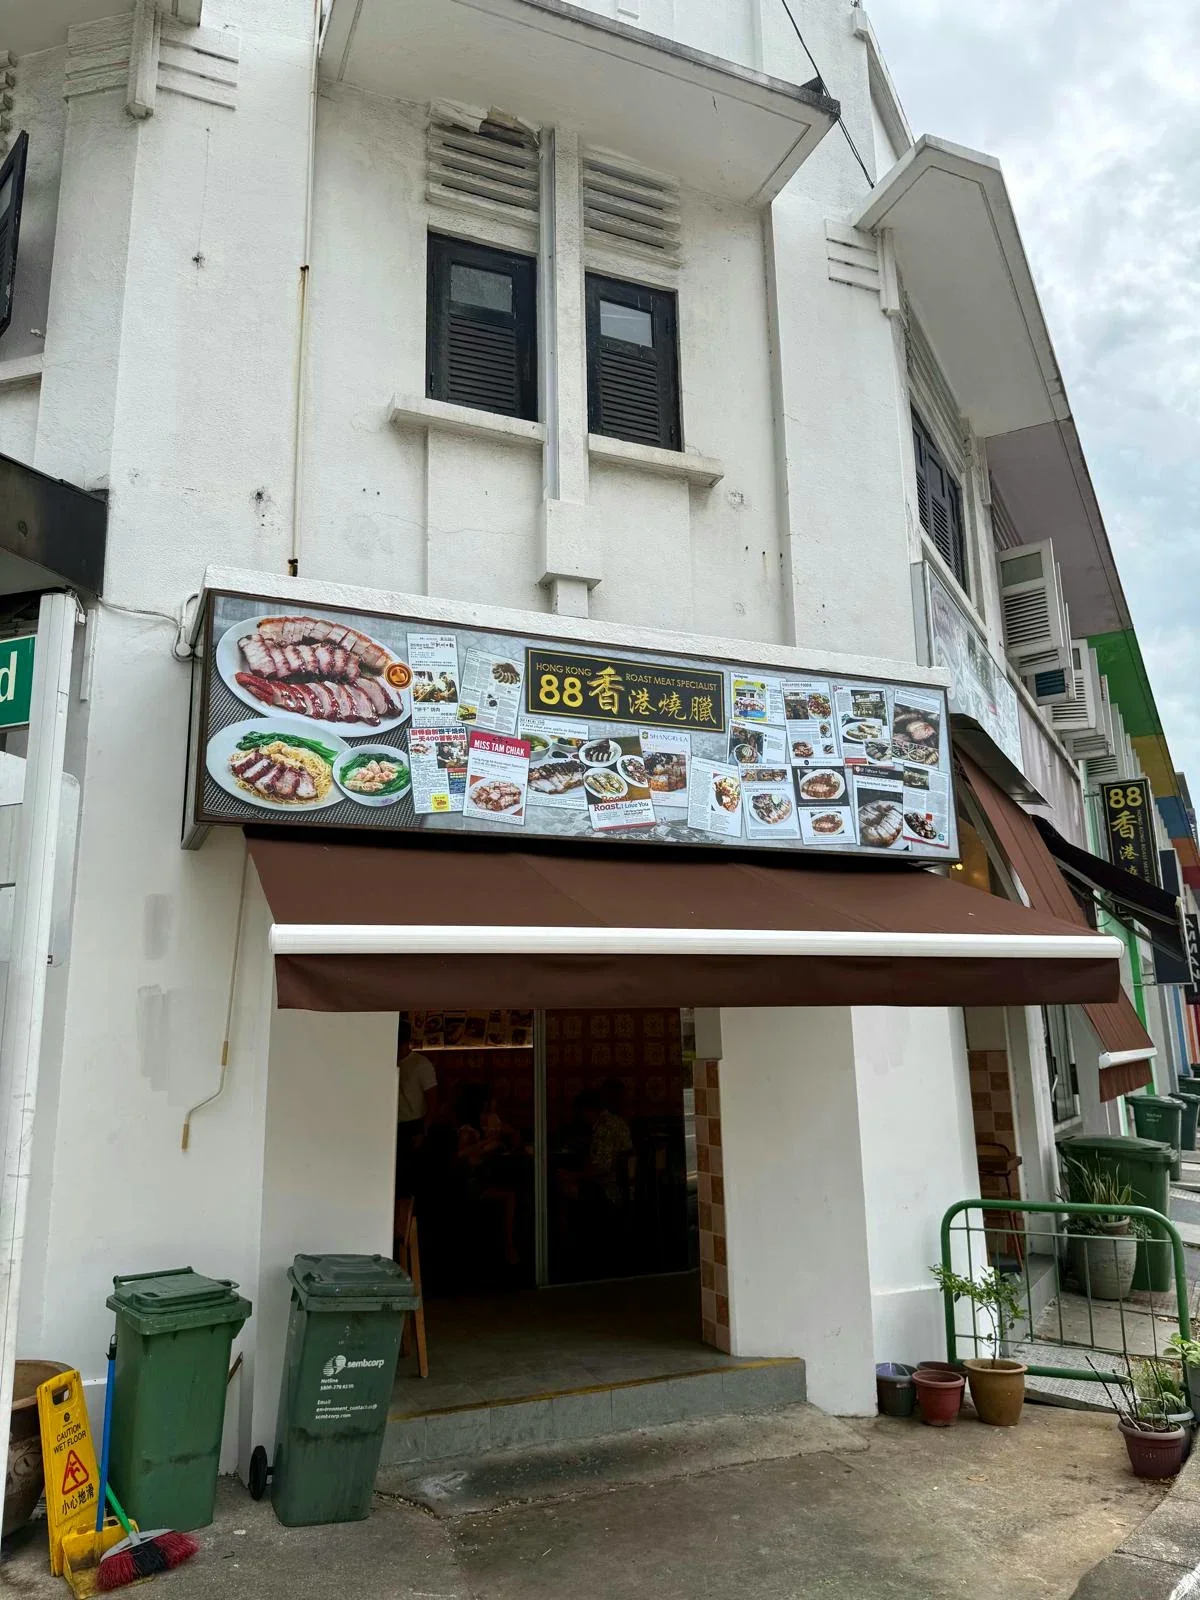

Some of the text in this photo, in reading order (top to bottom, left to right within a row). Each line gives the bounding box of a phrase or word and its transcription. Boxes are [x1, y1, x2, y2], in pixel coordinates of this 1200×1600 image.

[535, 662, 592, 677] HONG KONG
[538, 674, 584, 708] 88
[625, 673, 717, 691] ROAST MEAT SPECIALIST
[473, 739, 525, 757] MISS TAM CHIAK
[1109, 786, 1143, 809] 88
[347, 1358, 384, 1368] sembcorp
[53, 1430, 87, 1454] WET FLOOR
[56, 1422, 81, 1443] CAUTION
[61, 1483, 95, 1514] 小心地滑
